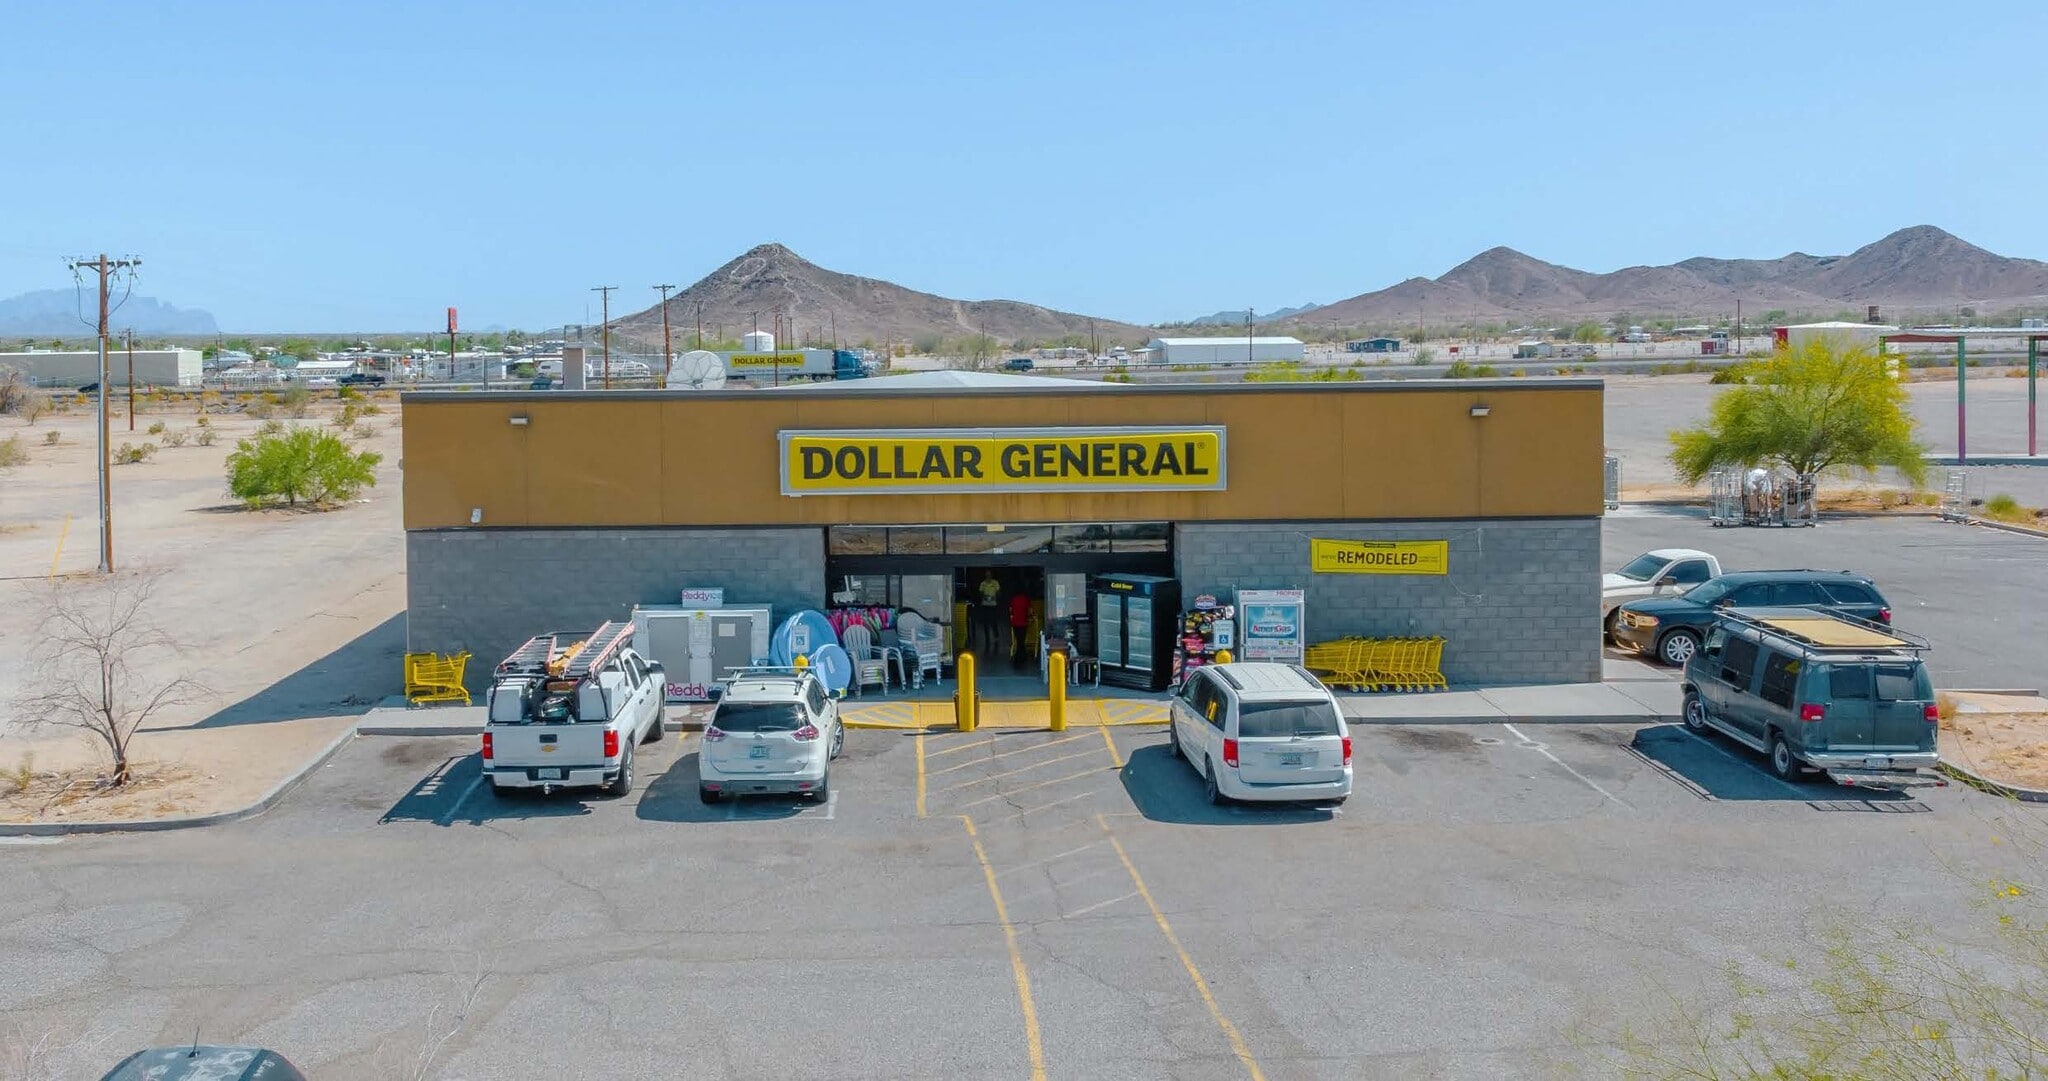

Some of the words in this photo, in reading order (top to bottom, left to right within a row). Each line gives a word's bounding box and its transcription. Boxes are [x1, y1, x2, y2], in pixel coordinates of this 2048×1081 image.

[800, 445, 984, 480] DOLLAR
[1001, 441, 1209, 477] GENERAL
[1337, 551, 1418, 565] REMODELED
[667, 683, 723, 699] Reddy
